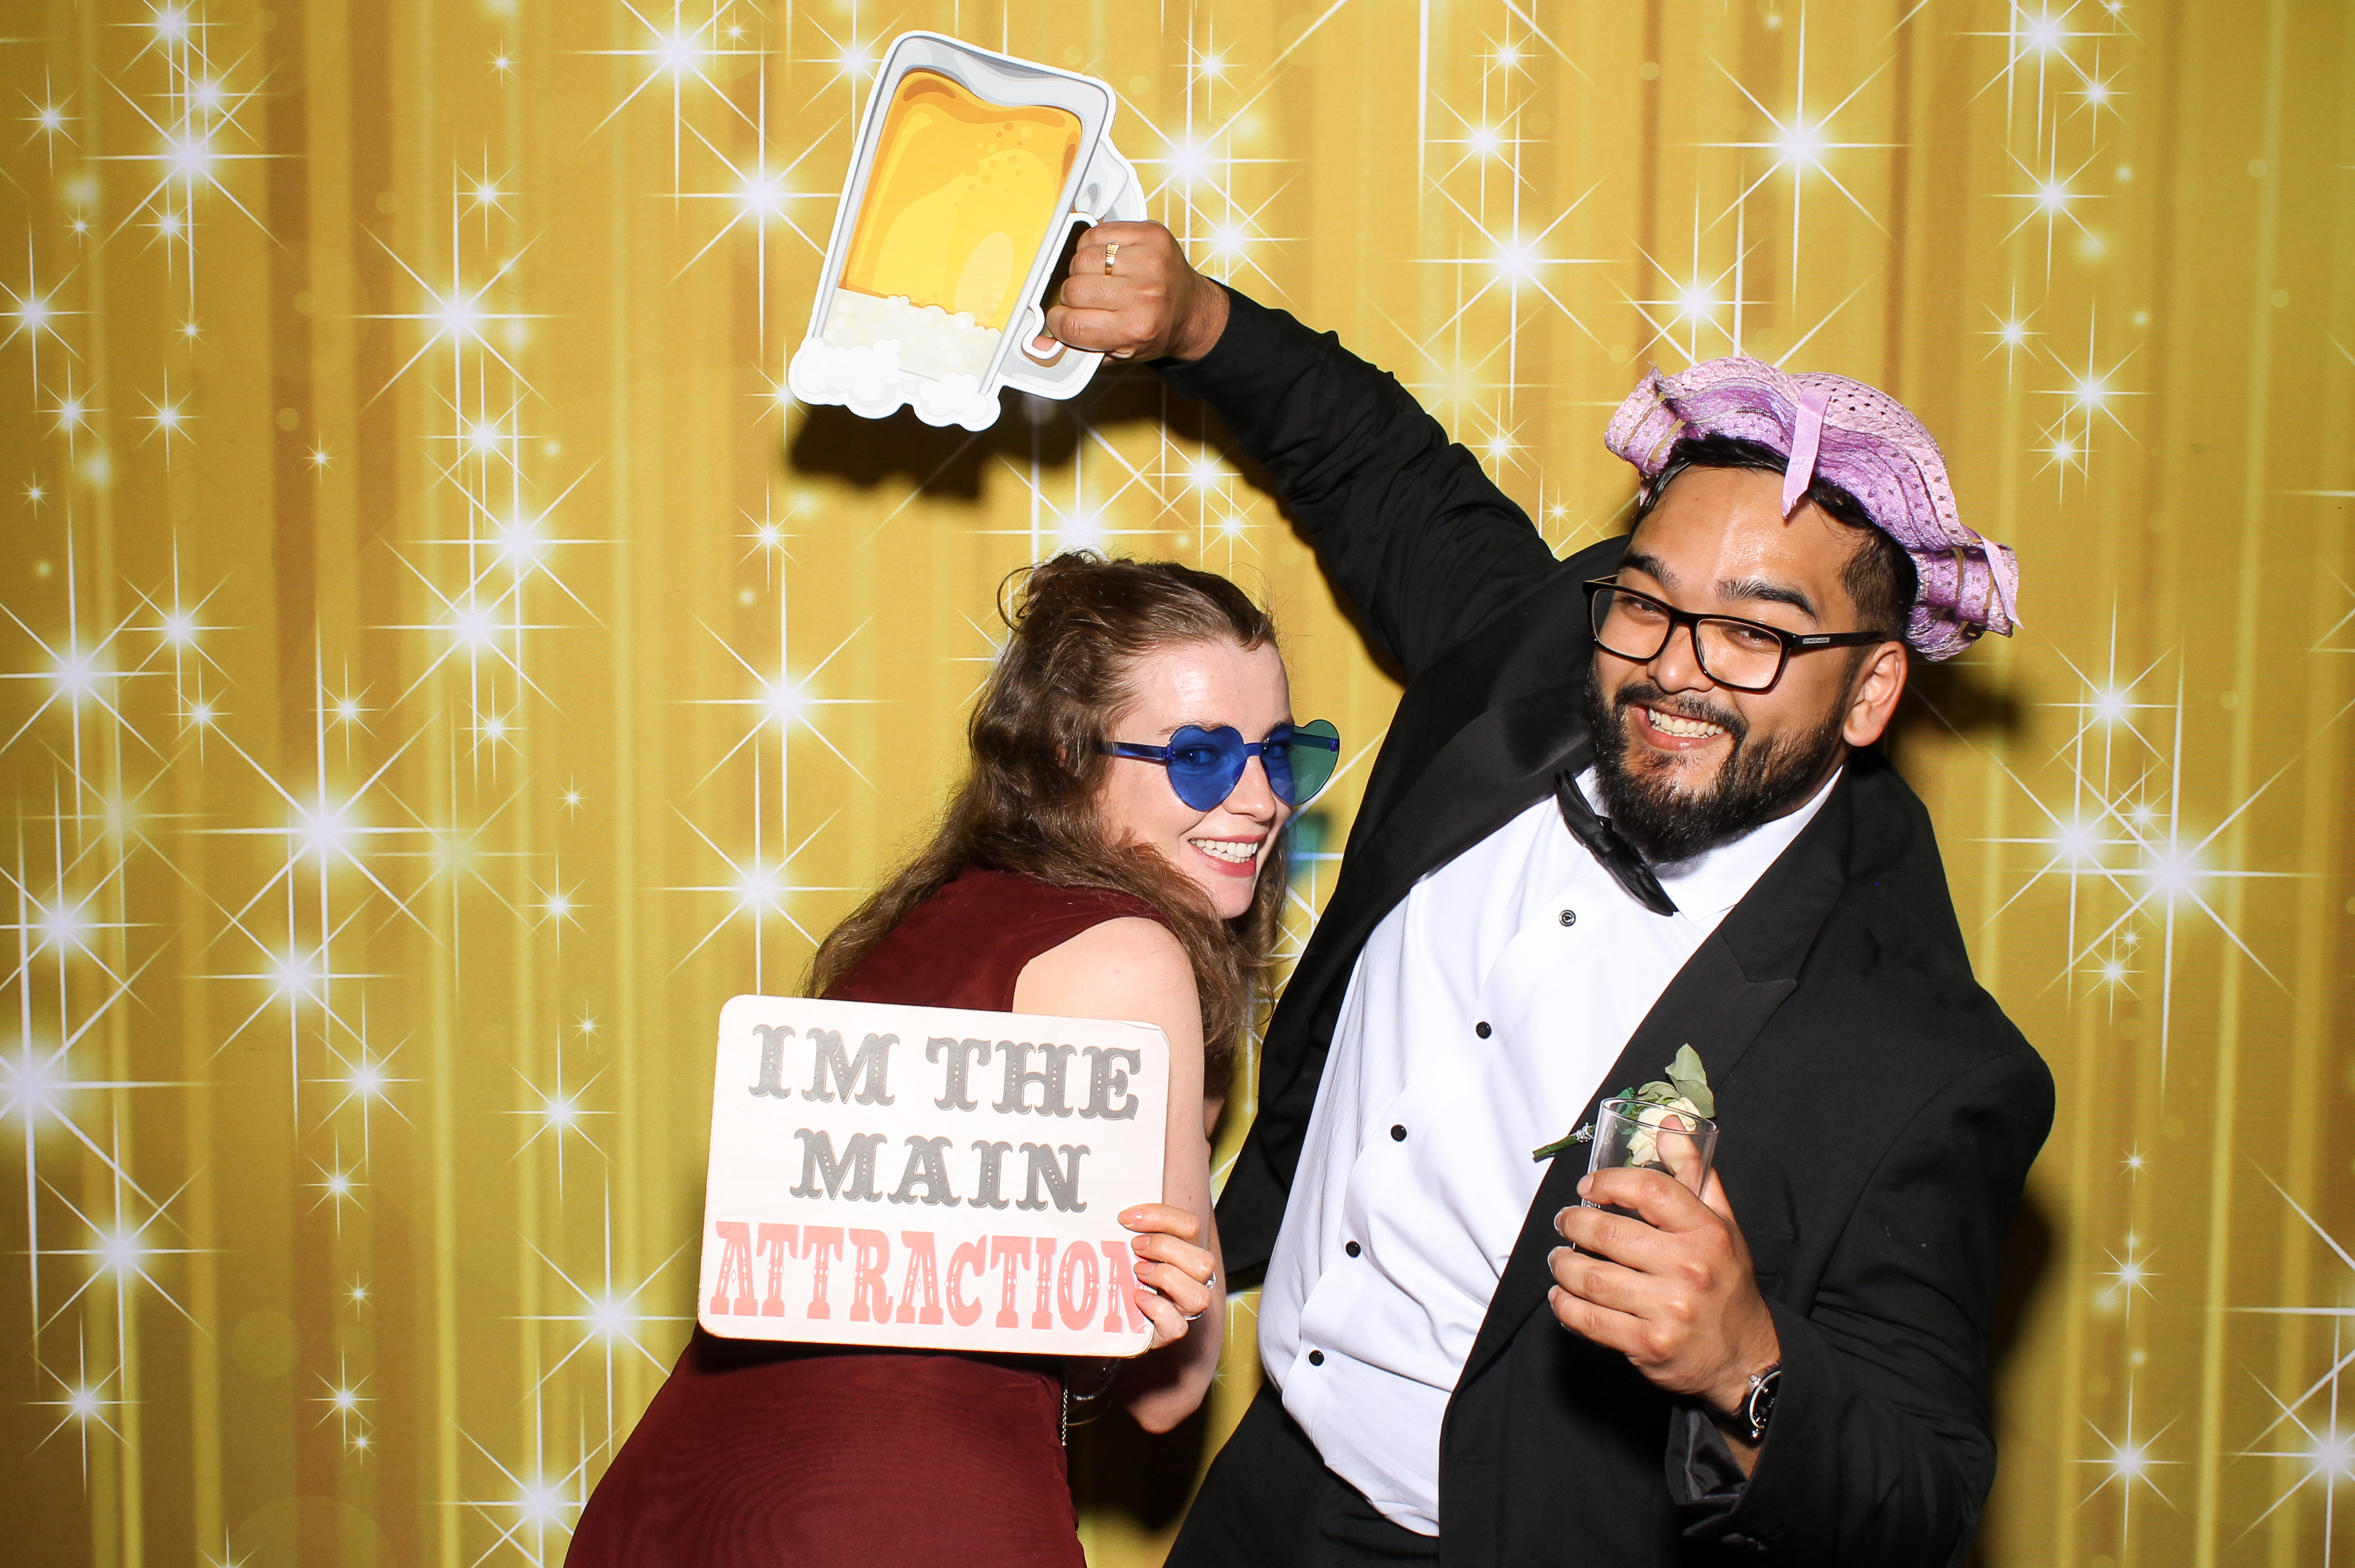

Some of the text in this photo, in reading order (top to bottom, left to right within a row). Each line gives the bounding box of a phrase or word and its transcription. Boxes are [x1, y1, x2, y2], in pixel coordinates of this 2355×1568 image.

[749, 1024, 1141, 1120] IM THE
[789, 1129, 1090, 1213] MAIN
[710, 1221, 1147, 1334] ATTRACTION
